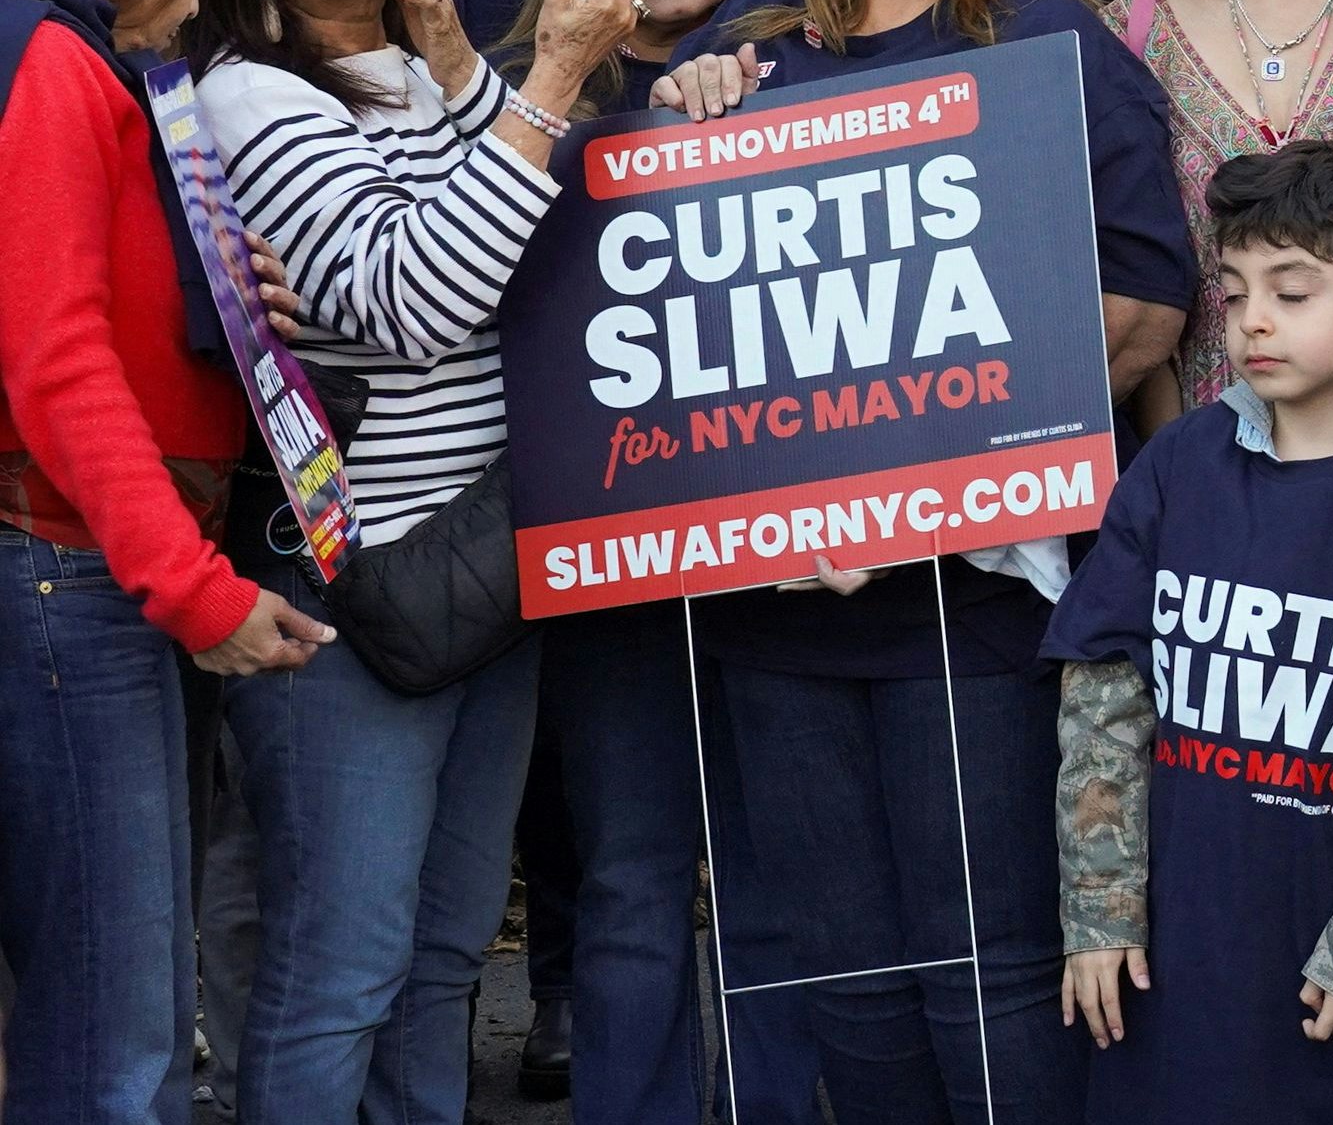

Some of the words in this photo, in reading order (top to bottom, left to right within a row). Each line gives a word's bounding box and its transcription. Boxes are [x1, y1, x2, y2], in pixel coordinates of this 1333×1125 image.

[604, 139, 702, 180] VOTE
[709, 102, 911, 164] NOVEMBER
[918, 83, 969, 123] 4TH
[599, 150, 981, 295] CURTIS
[586, 246, 1012, 408] SLIWA
[266, 388, 326, 471] SLIWA
[604, 417, 680, 488] for
[690, 397, 801, 452] NYC
[813, 361, 1008, 431] MAYOR
[546, 460, 1095, 589] SLIWAFORNYC.COM
[1179, 735, 1241, 780] NYC
[1275, 795, 1292, 807] FOR
